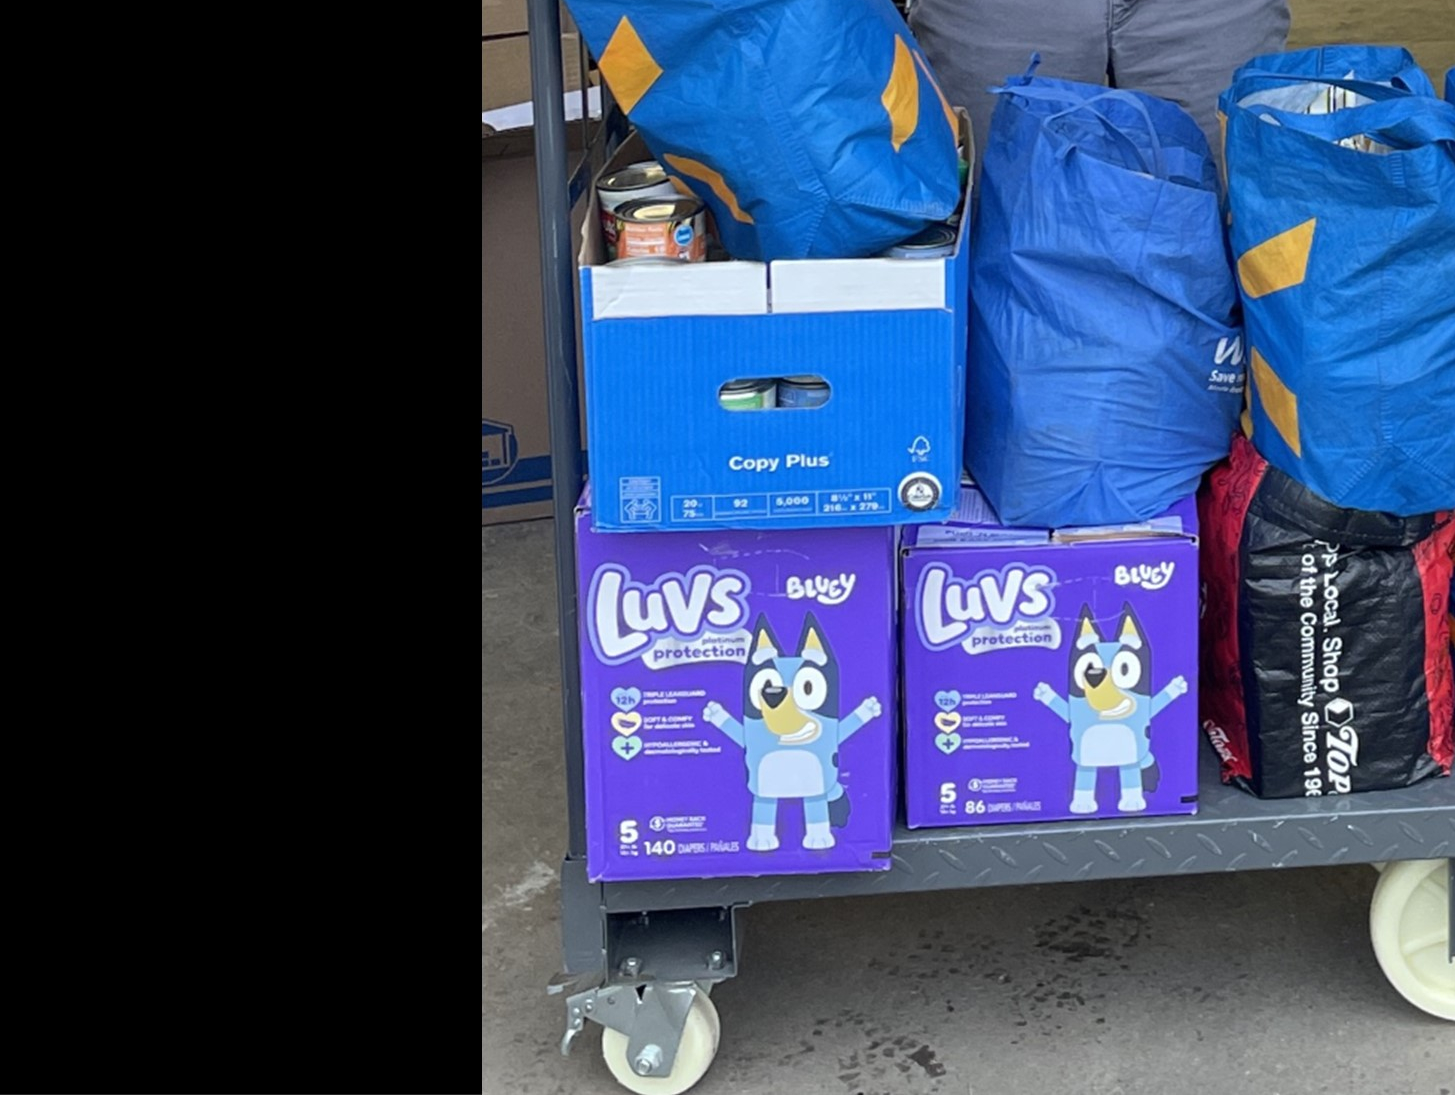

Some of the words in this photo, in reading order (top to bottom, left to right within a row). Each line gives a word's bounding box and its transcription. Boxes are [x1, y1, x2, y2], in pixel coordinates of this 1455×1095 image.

[1208, 370, 1236, 383] Save
[728, 455, 779, 473] Copy
[785, 453, 830, 468] Plus
[733, 499, 748, 508] 92
[775, 496, 810, 507] 5,000
[1301, 553, 1318, 574] of
[1300, 576, 1317, 609] the
[702, 636, 746, 645] platinum
[972, 632, 1052, 647] protection
[653, 644, 746, 661] protection
[1297, 611, 1318, 708] Community
[1319, 636, 1343, 693] Shop
[1301, 711, 1320, 764] Since
[940, 782, 957, 804] 5
[965, 800, 986, 814] 86
[619, 820, 639, 843] 5
[644, 840, 676, 855] 140
